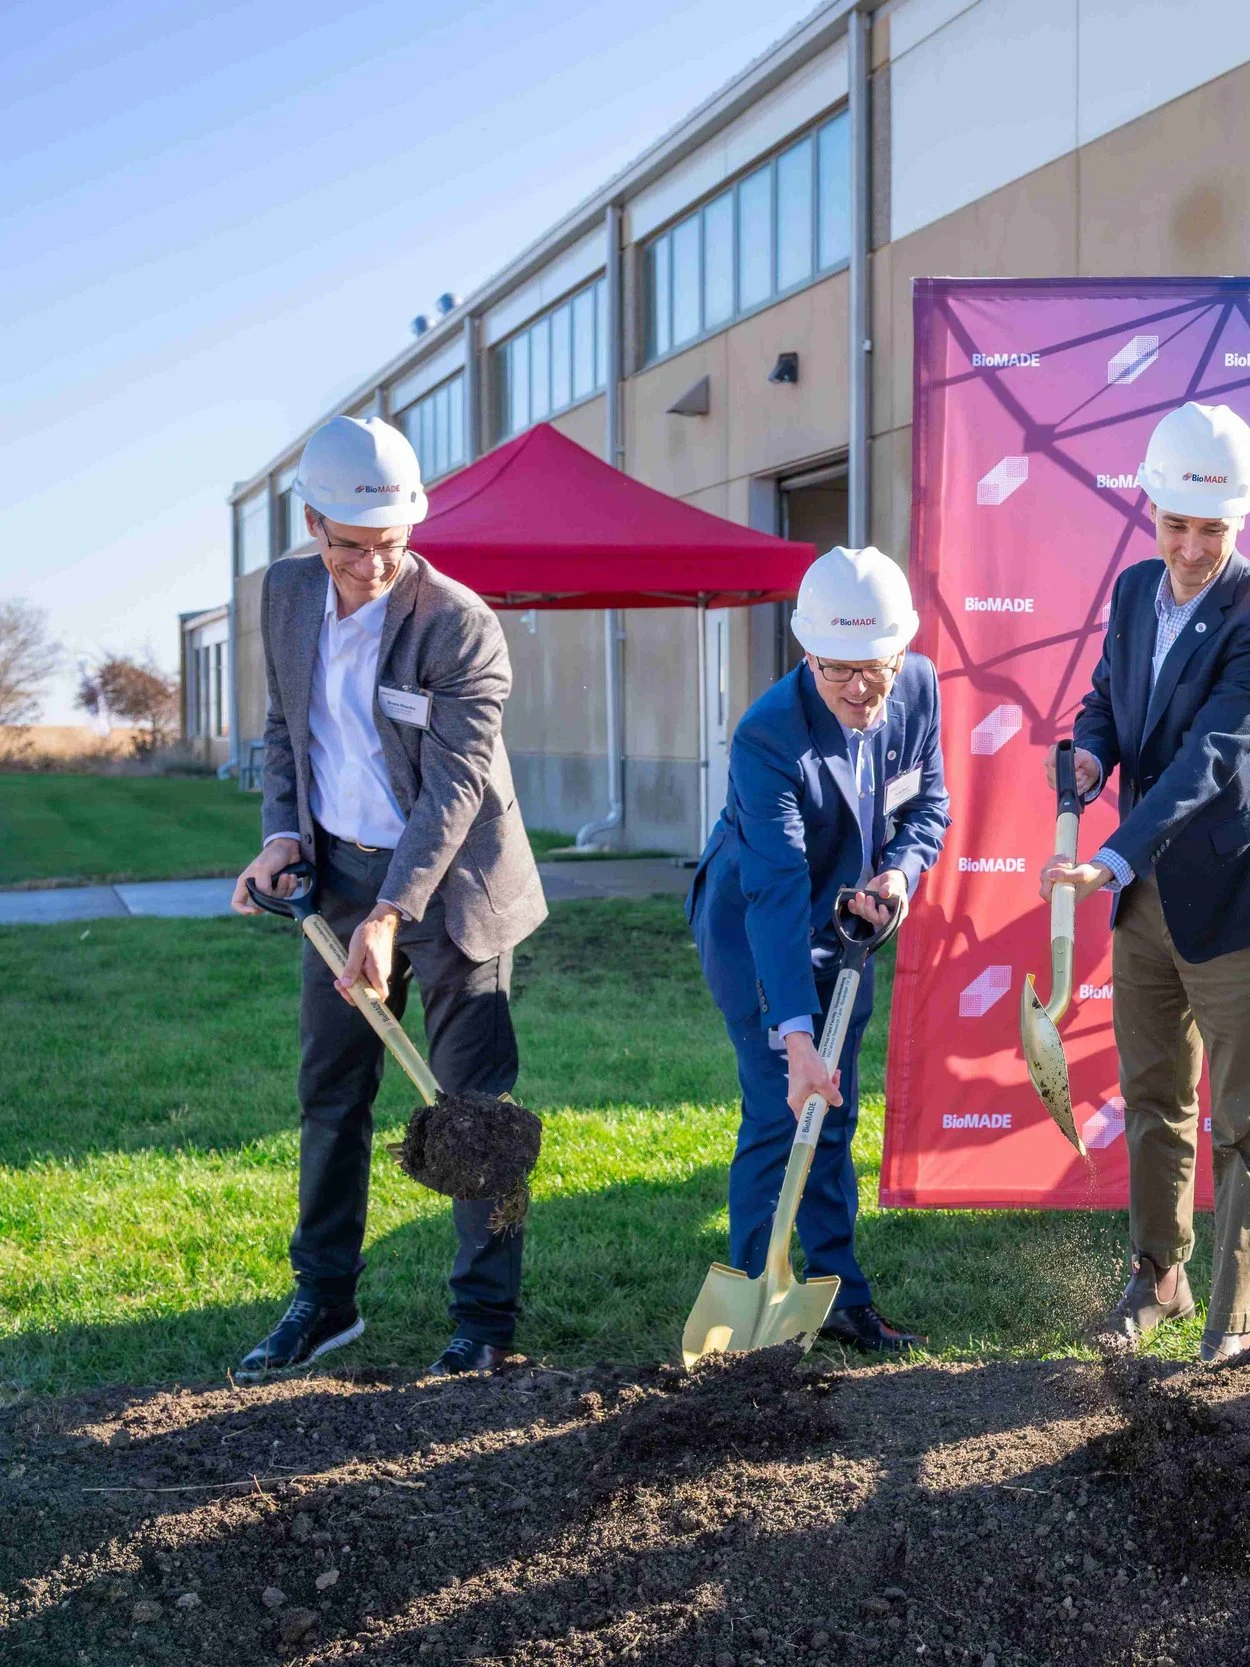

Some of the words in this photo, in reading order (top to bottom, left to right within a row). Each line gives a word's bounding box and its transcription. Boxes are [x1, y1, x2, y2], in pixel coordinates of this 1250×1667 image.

[972, 352, 1041, 367] BioMADE
[1096, 474, 1141, 488] BioMA
[1191, 474, 1228, 484] BioMADE
[365, 484, 400, 493] BioMADE
[964, 597, 1034, 612] BioMADE
[840, 617, 877, 626] BioMADE
[958, 857, 1026, 872] BioMADE
[1079, 984, 1113, 999] BioM
[802, 1101, 817, 1134] BioMADE
[942, 1114, 1012, 1129] BioMADE
